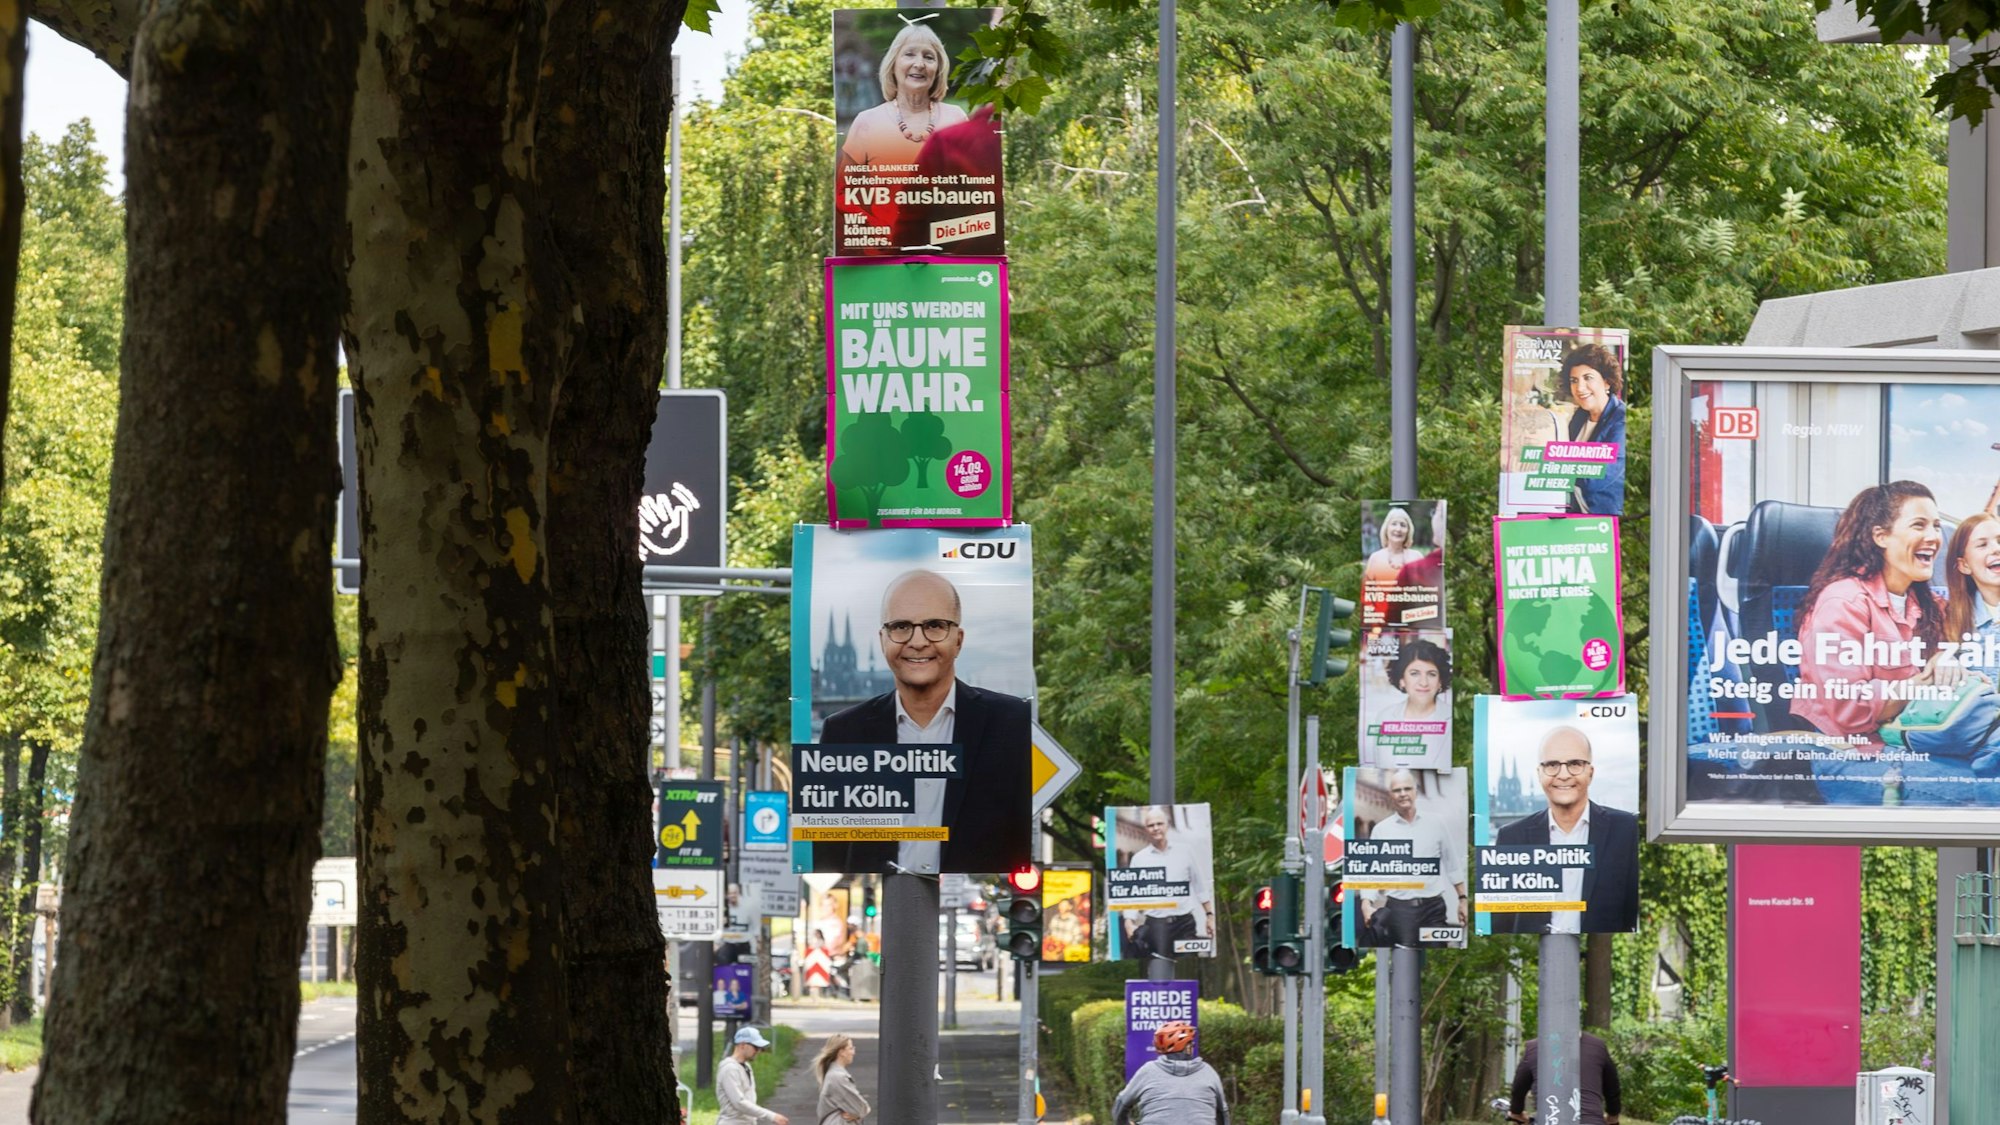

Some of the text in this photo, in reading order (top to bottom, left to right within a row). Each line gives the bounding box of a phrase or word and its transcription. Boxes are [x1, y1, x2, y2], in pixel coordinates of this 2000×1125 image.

[879, 164, 919, 172] BANKERT
[844, 174, 995, 185] Verkehrswende statt Tunnel
[844, 187, 995, 205] KVB ausbauen
[844, 212, 867, 224] Wir
[844, 224, 891, 236] können
[936, 218, 991, 239] Die Linke
[844, 235, 892, 246] anders.
[841, 301, 985, 320] MIT UNS WERDEN
[841, 319, 987, 368] BÄUME
[1515, 349, 1562, 360] AYMAZ
[841, 372, 984, 414] WAHR.
[1719, 412, 1754, 435] DB
[1781, 423, 1864, 438] Regio NRW
[961, 455, 973, 463] Am
[1524, 445, 1614, 460] MIT SOLIDARITÄT.
[954, 461, 984, 477] 14.09.
[1542, 462, 1603, 476] FÜR DIE STADT
[1528, 477, 1571, 489] MIT HERZ.
[877, 508, 910, 516] ZUSAMMEN
[911, 507, 923, 515] FÜR
[959, 542, 1016, 559] CDU
[1506, 543, 1608, 557] MIT UNS KRIEGT DAS
[1506, 556, 1597, 586] KLIMA
[1364, 592, 1439, 603] KVB ausbauen
[1508, 586, 1594, 600] NICHT DIE KRISE.
[1367, 645, 1399, 655] AYMAZ
[1709, 630, 1803, 672] Jede
[1815, 632, 1927, 667] Fahrt
[1709, 677, 1773, 704] Steig
[1778, 680, 1817, 699] ein
[1824, 679, 1874, 700] fürs
[1591, 706, 1626, 718] CDU
[1709, 732, 1872, 747] Wir bringen dich gern hin.
[801, 750, 956, 773] Neue Politik
[1707, 749, 1930, 763] Mehr dazu auf bahn.de/nrw-jedefahrt
[801, 784, 909, 808] für Köln.
[802, 815, 900, 826] Markus Greitemann
[801, 828, 946, 841] Ihr neuer Oberbürgermeister
[1348, 841, 1411, 855] Kein Amt
[1481, 848, 1591, 866] Neue Politik
[1348, 860, 1438, 875] für Anfänger.
[1111, 869, 1165, 881] Kein Amt
[1481, 872, 1560, 890] für Köln.
[670, 888, 679, 897] U
[1111, 884, 1189, 897] für Anfänger.
[1748, 897, 1771, 906] Innere
[1771, 897, 1791, 906] Kanal
[1792, 897, 1804, 906] Str.
[1431, 930, 1460, 939] CDU
[1184, 942, 1209, 950] CDU
[1131, 991, 1192, 1006] FRIEDE
[1131, 1006, 1192, 1020] FREUDE
